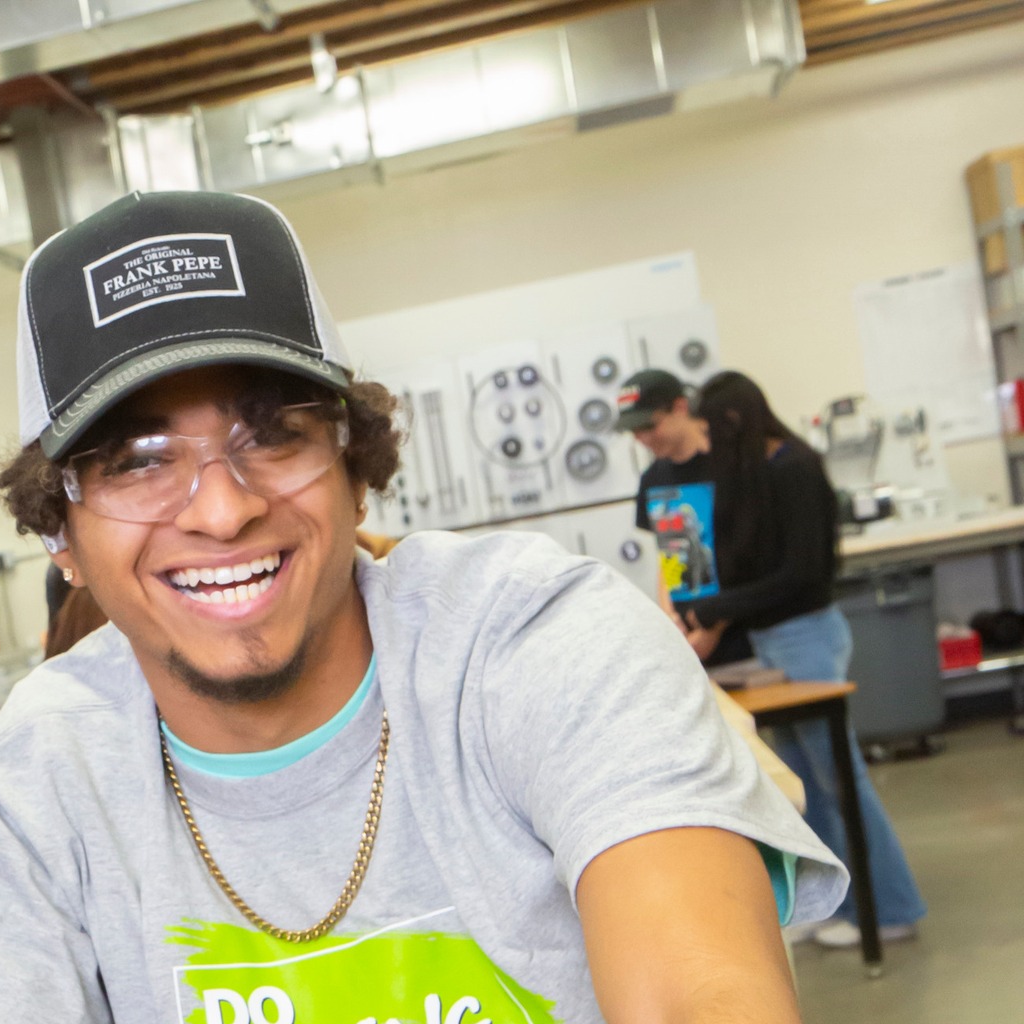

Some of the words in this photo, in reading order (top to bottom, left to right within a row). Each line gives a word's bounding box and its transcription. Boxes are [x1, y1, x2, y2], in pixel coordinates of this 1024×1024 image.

[123, 256, 143, 270] THE
[144, 248, 194, 261] ORIGINAL
[103, 260, 169, 295] FRANK
[171, 255, 223, 272] PEPE
[112, 281, 152, 302] PIZZERIA
[152, 271, 216, 286] NAPOLETANA
